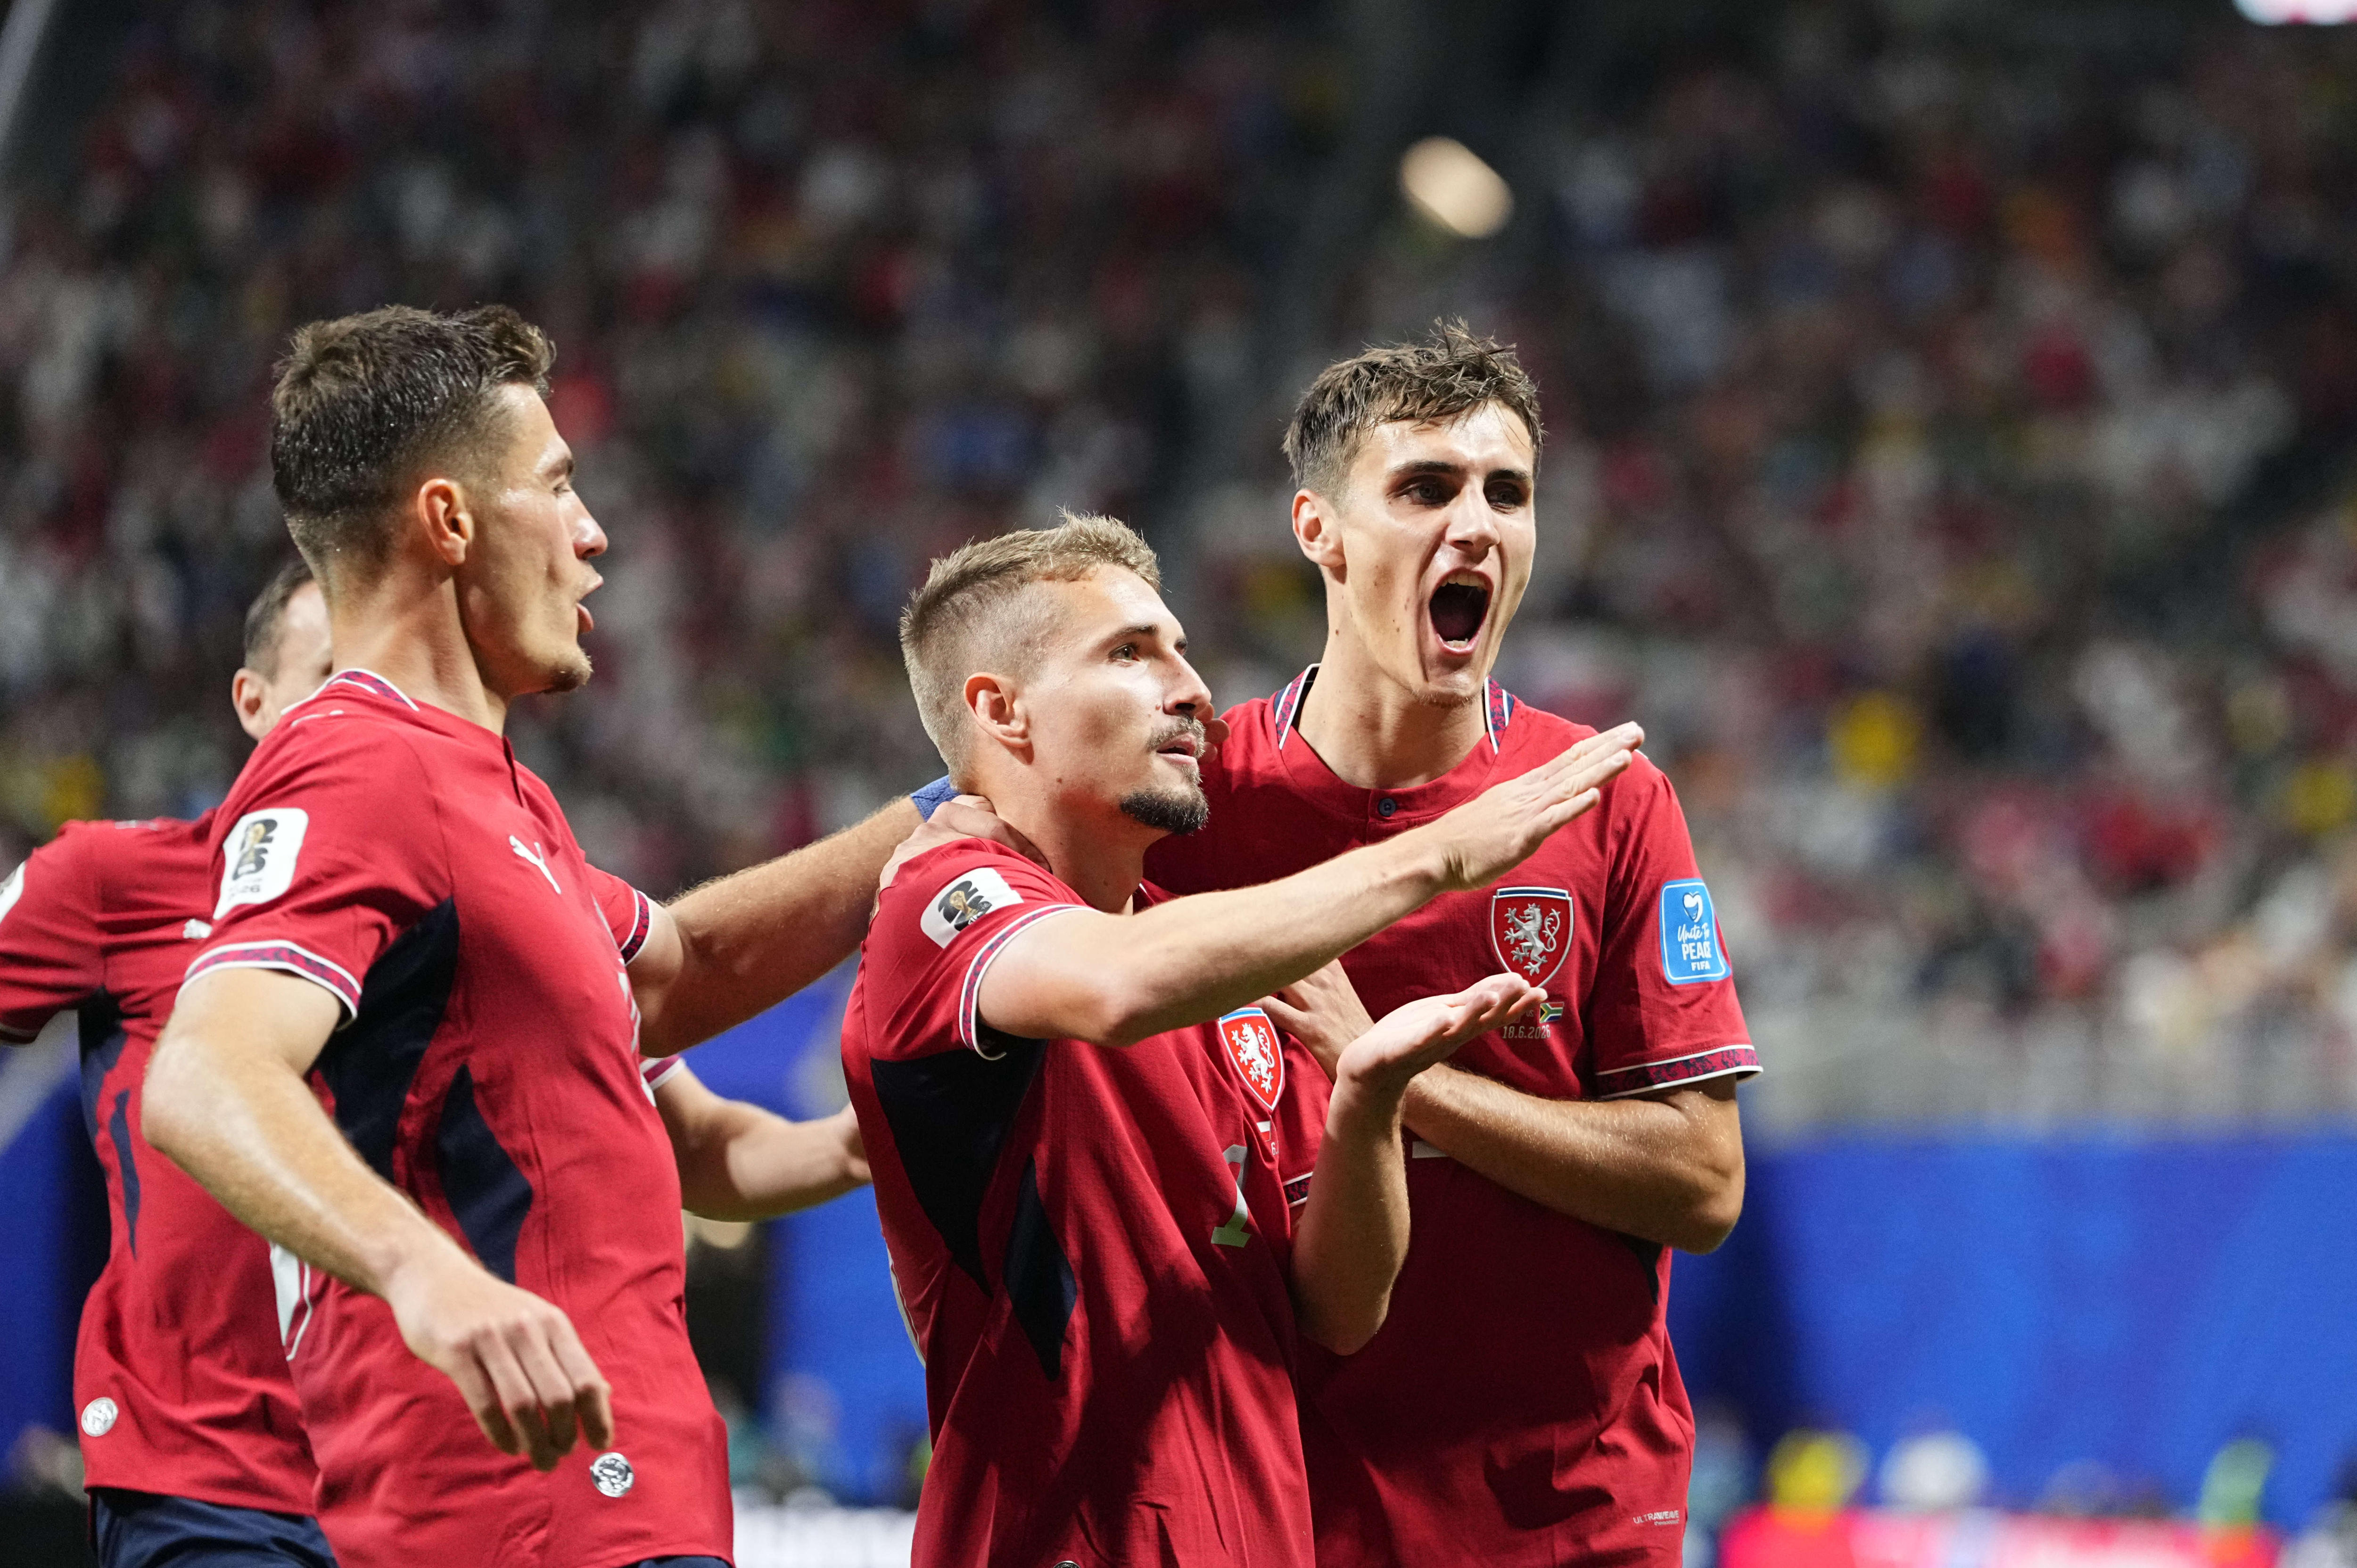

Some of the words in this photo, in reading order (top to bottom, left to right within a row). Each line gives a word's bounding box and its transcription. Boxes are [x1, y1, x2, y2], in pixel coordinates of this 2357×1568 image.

[1678, 924, 1703, 943] Unite
[1691, 960, 1711, 971] FIFA
[1502, 1024, 1550, 1040] 18.6.2026
[1633, 1510, 1679, 1524] ULTRAWEAVE
